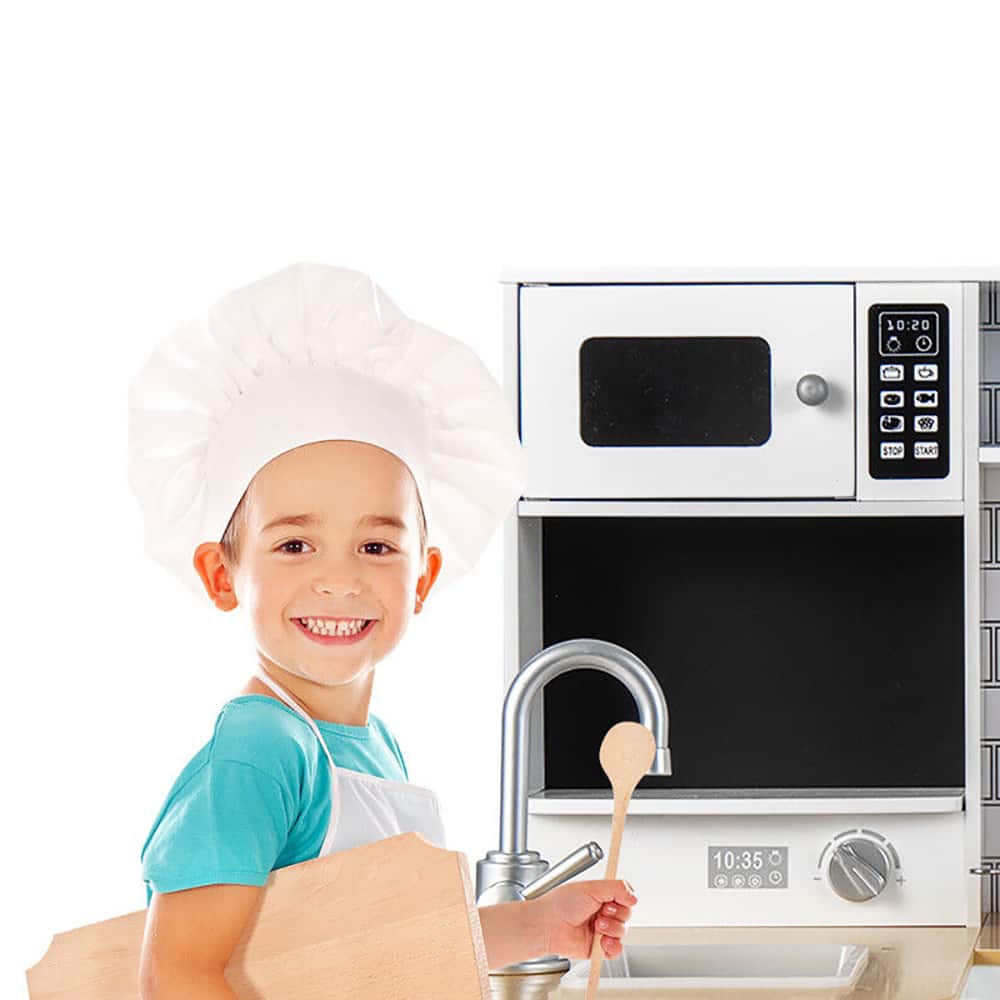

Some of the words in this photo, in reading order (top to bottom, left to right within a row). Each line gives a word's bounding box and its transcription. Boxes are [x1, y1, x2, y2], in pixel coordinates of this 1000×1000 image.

[882, 445, 903, 456] STOP
[914, 445, 938, 456] START
[712, 850, 764, 870] 10:35
